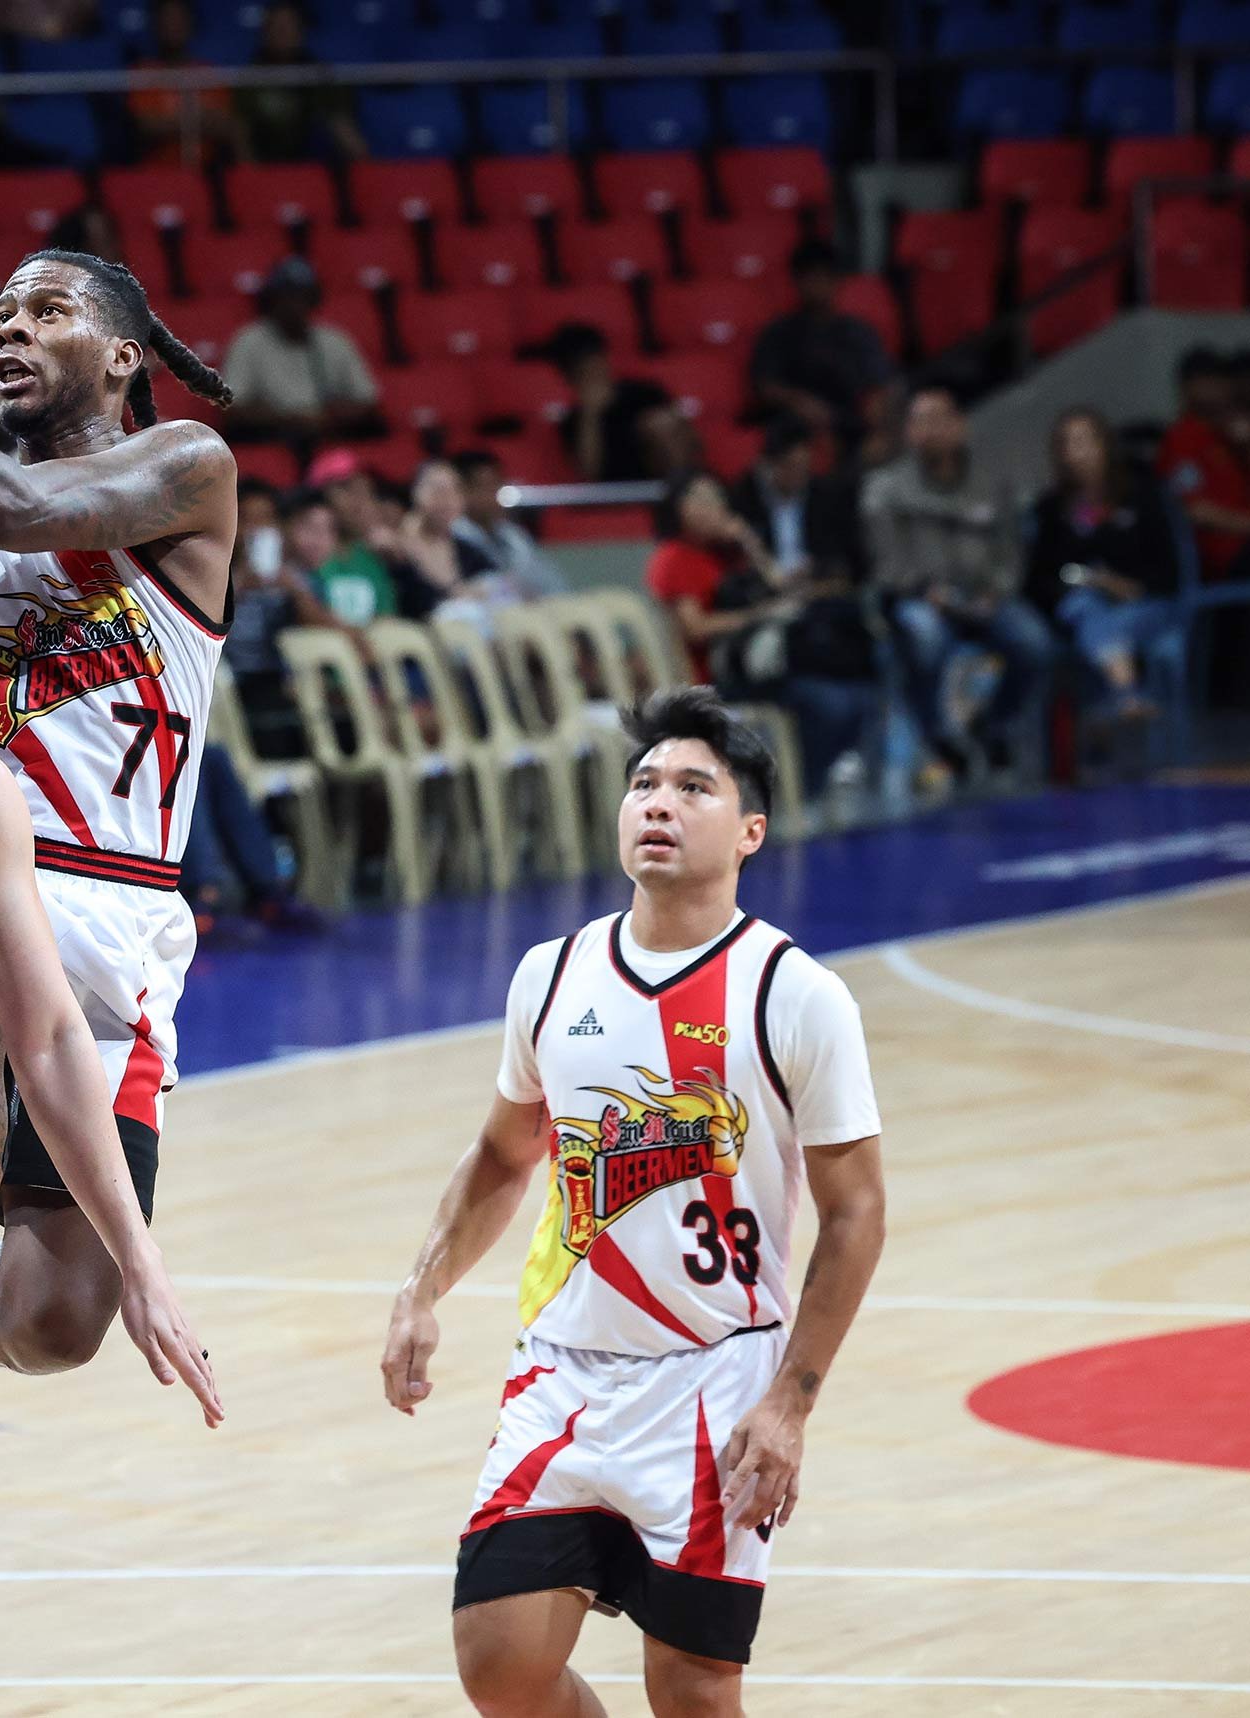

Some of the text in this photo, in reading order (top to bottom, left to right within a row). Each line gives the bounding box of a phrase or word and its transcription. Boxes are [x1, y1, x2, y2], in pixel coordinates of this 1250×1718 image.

[28, 642, 144, 709] BEERMEN
[111, 702, 190, 809] 77
[568, 1026, 604, 1036] DELTA
[607, 1142, 713, 1214] BEERMEN
[682, 1200, 760, 1286] 33
